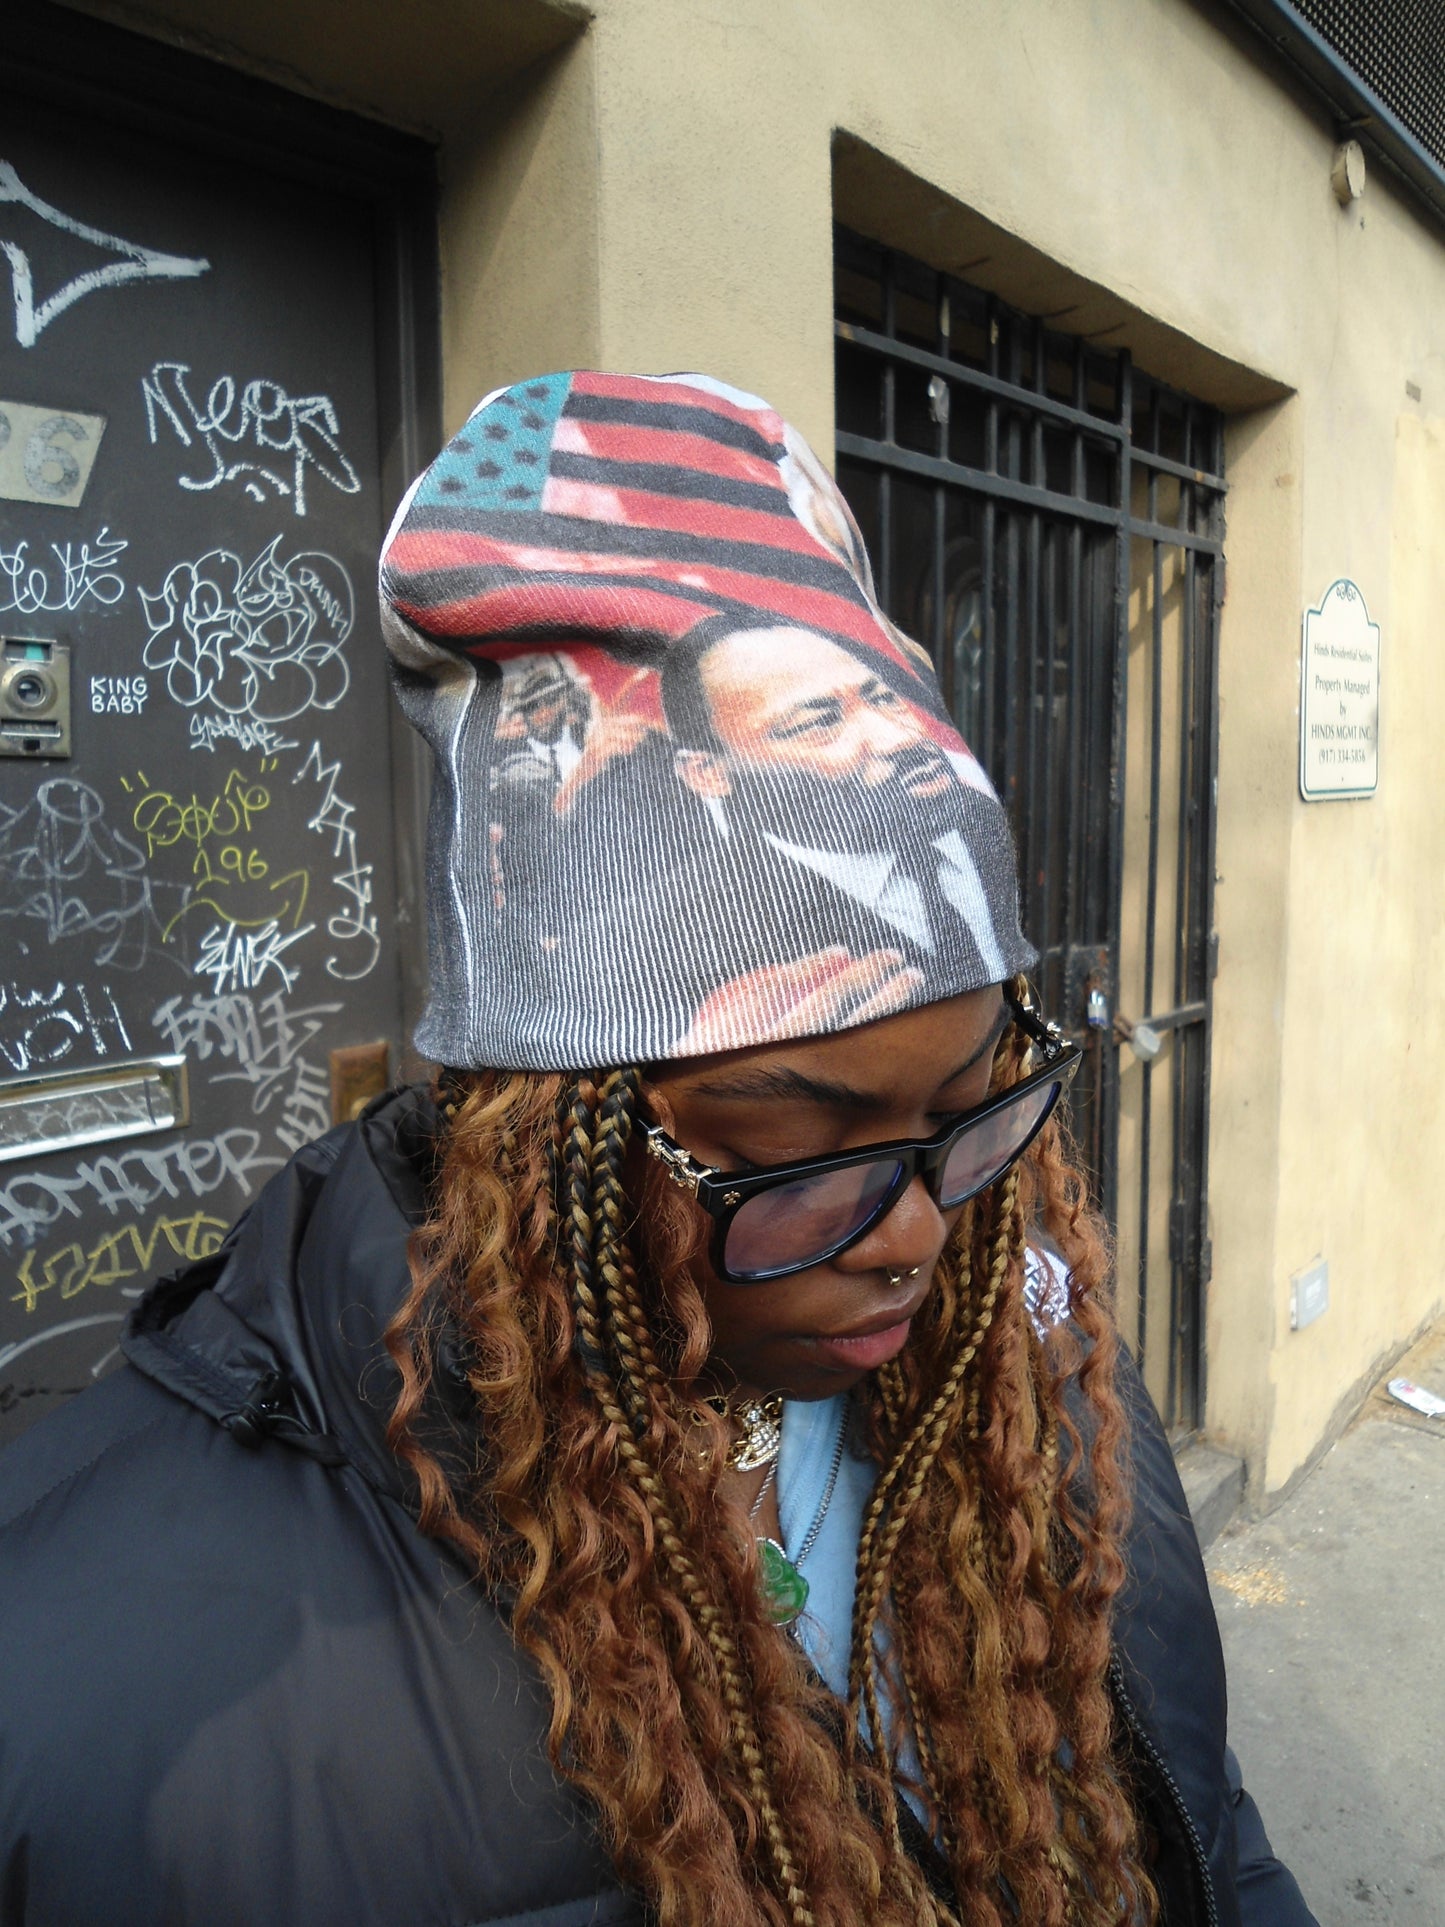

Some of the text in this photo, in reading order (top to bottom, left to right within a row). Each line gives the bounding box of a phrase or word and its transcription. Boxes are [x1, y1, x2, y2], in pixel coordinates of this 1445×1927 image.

[90, 676, 148, 696] KING
[1344, 679, 1370, 698] Managed
[91, 694, 148, 714] BABY
[1339, 701, 1347, 720] by
[1311, 723, 1335, 739] HINDS
[1336, 725, 1357, 740] MGMT
